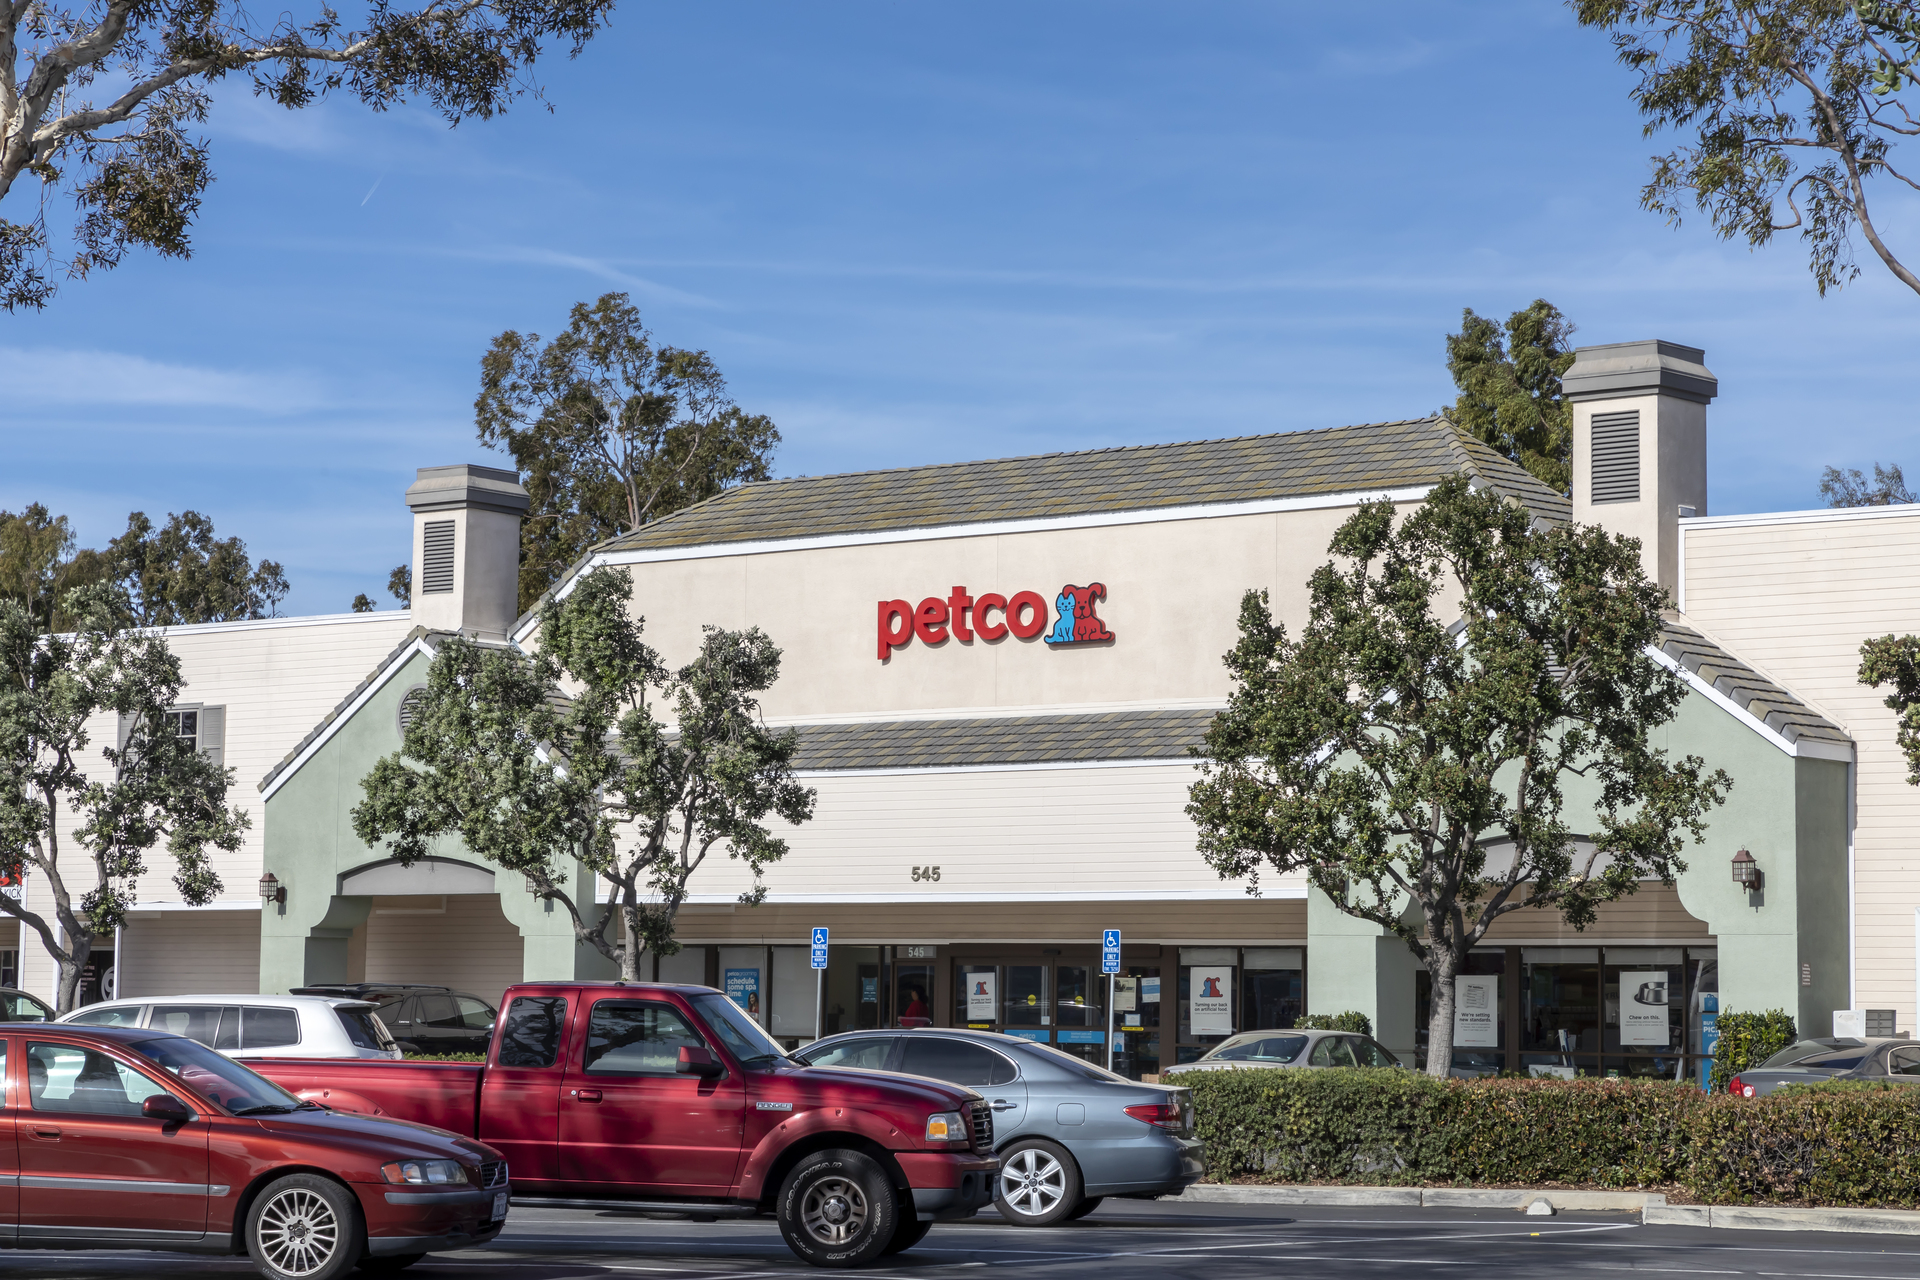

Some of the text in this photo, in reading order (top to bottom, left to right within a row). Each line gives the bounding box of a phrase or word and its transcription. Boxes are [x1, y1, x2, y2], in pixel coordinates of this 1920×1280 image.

[877, 585, 1049, 661] petco
[911, 866, 941, 882] 545
[908, 947, 924, 957] 545
[727, 977, 755, 985] schedule
[785, 1161, 843, 1221] GOODYEAR
[826, 1202, 882, 1259] WRANGLER
